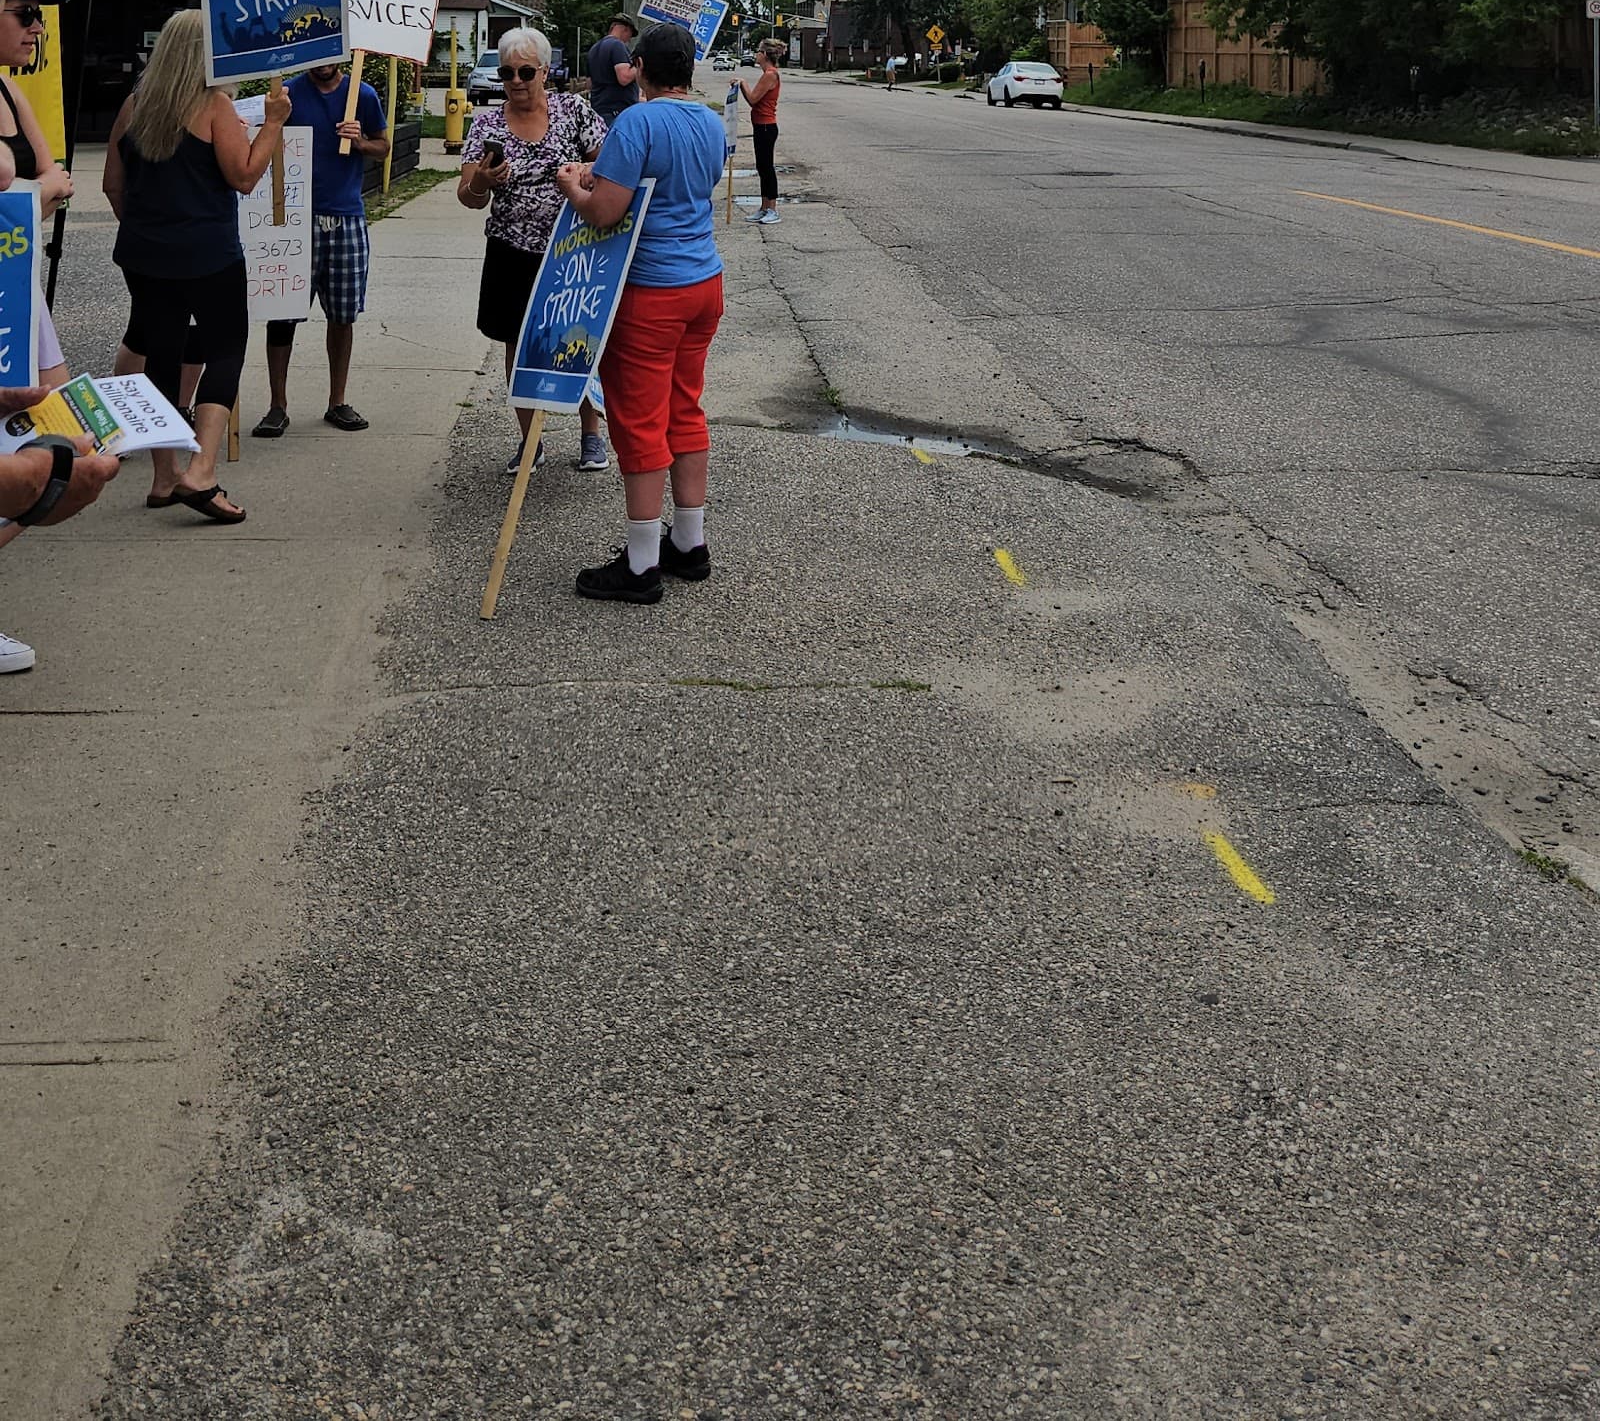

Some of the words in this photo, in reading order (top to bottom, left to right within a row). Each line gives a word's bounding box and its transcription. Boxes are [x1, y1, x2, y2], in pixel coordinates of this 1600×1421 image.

[348, 0, 434, 30] RVICES
[258, 264, 288, 275] FOR
[564, 248, 596, 286] ON
[538, 285, 607, 330] STRIKE
[99, 382, 149, 434] billionaire
[120, 379, 146, 398] Say
[136, 399, 156, 415] no
[154, 413, 168, 428] to
